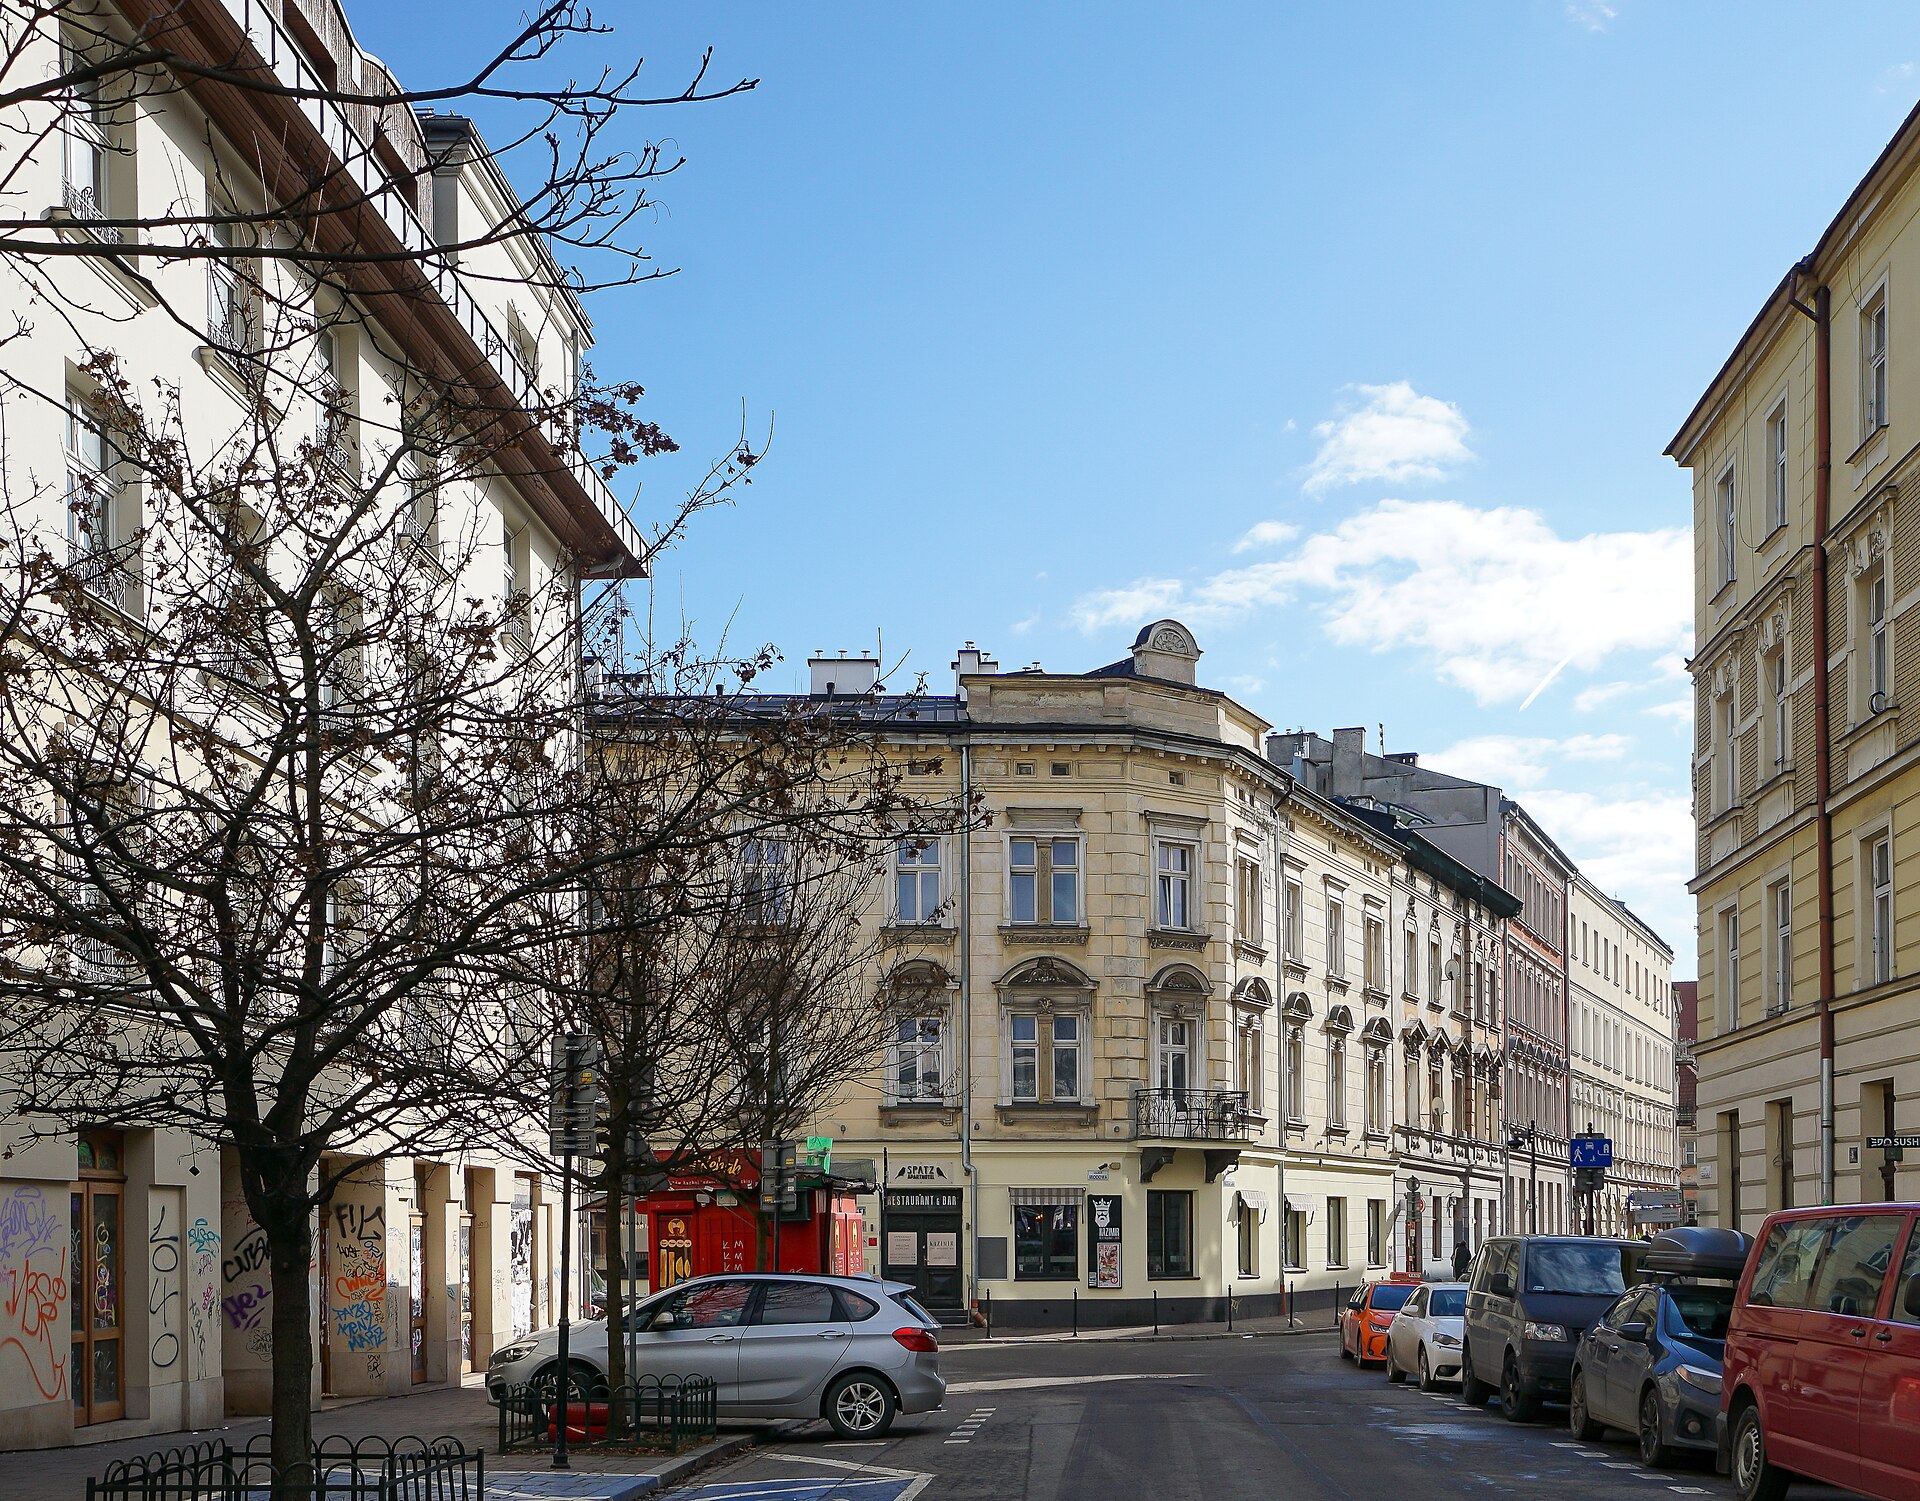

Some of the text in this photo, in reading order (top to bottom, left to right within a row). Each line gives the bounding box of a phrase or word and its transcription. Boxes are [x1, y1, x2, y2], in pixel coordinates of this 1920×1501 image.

[907, 1165, 934, 1174] SPATZ
[887, 1195, 934, 1206] RESTAURANT
[942, 1195, 957, 1206] BAR
